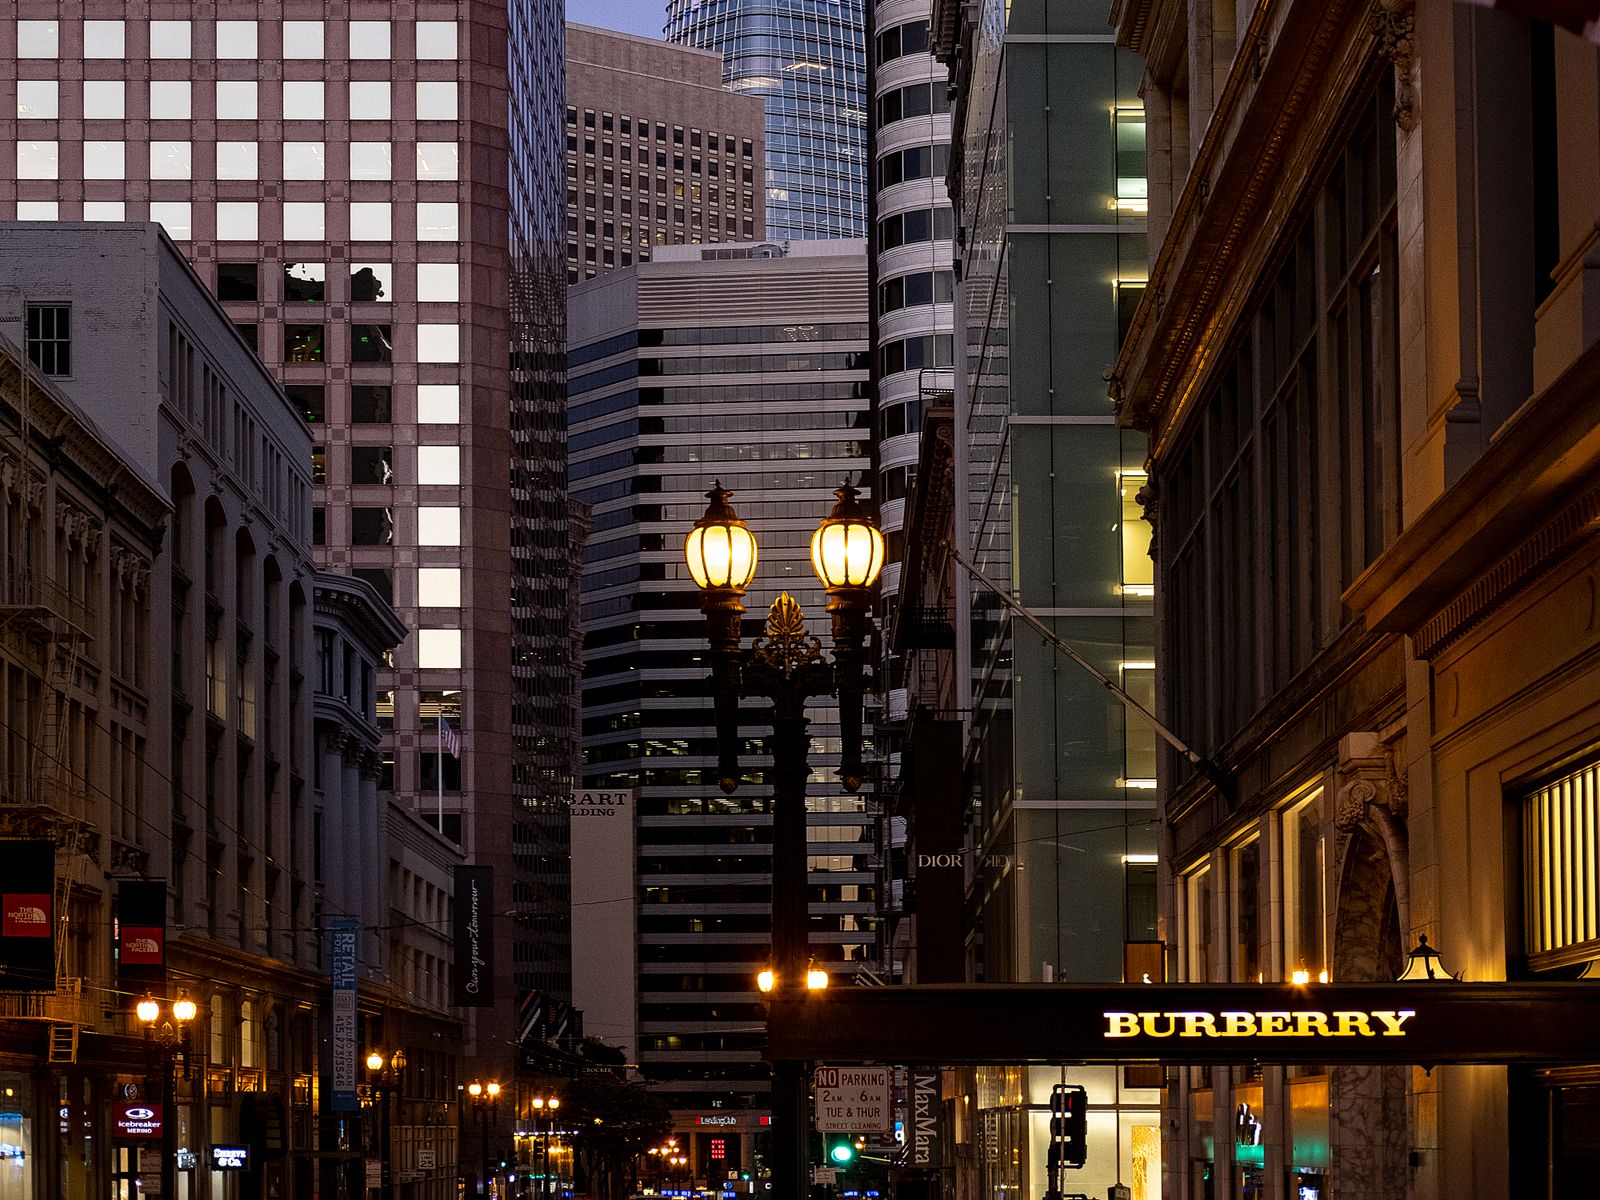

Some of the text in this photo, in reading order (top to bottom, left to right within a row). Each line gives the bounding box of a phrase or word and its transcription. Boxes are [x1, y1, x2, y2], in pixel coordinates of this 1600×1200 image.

[571, 808, 615, 816] LDING
[918, 854, 963, 868] DIOR
[466, 879, 479, 938] tomorrow
[333, 933, 342, 987] FOR LEASE
[342, 933, 356, 987] RETAIL
[471, 938, 485, 966] your
[1104, 1010, 1416, 1037] BURBERRY
[345, 1050, 353, 1087] MORGAN
[818, 1069, 885, 1087] NO PARKING
[700, 1116, 737, 1127] LendingClub
[825, 1107, 881, 1118] TUE & THUR
[914, 1074, 937, 1164] MaxMara
[118, 1120, 162, 1128] icebreaker
[825, 1122, 881, 1130] STREET CLEANING
